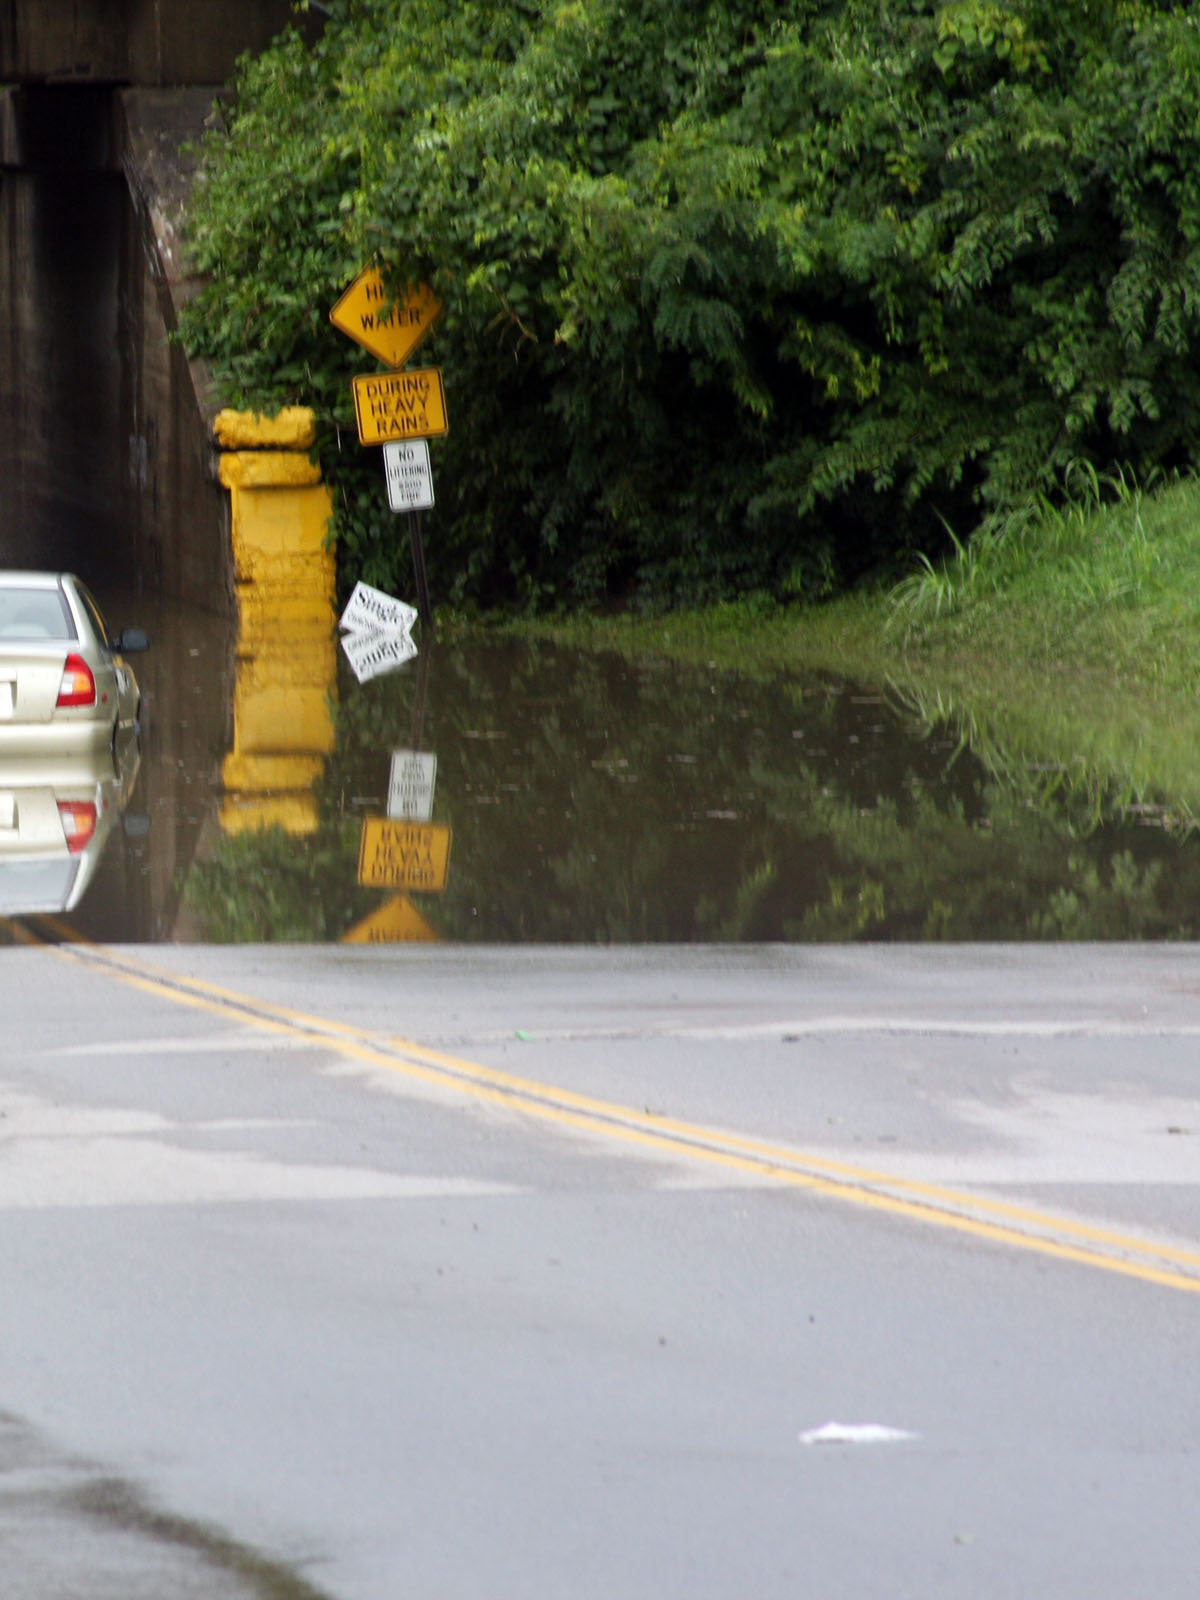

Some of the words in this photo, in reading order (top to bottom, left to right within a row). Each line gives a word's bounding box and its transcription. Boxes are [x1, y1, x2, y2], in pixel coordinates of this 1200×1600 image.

[361, 308, 422, 331] WATER
[366, 374, 430, 399] DURING
[371, 394, 429, 418] HEAVY
[377, 413, 429, 435] RAINS
[398, 448, 415, 462] NO
[389, 463, 428, 481] LITTERING
